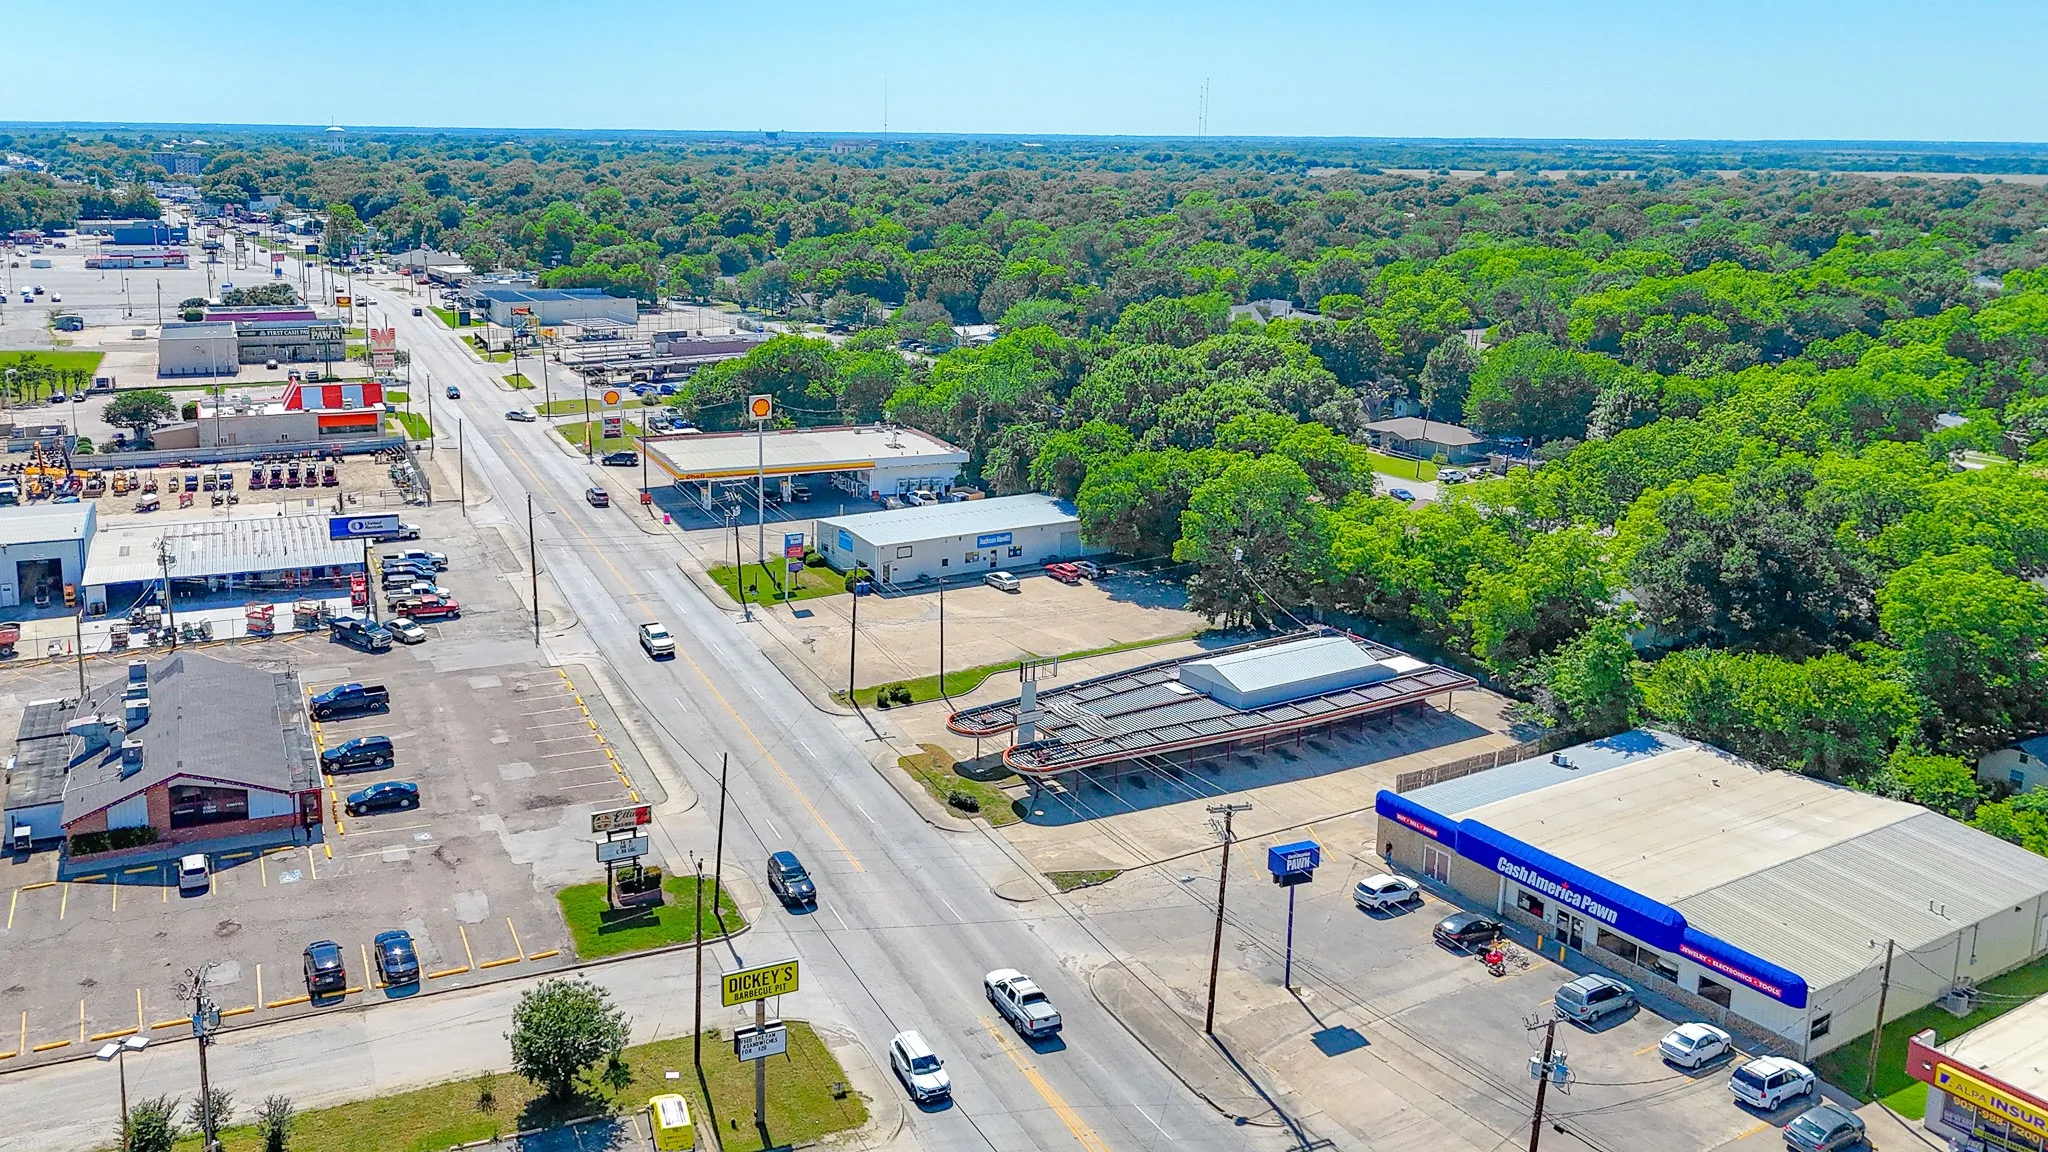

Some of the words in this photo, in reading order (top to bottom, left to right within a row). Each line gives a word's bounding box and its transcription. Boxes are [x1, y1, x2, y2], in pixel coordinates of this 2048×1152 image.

[310, 330, 340, 340] PAWN
[1287, 857, 1310, 871] PAWN
[729, 966, 793, 993] DICKEY'S
[1681, 946, 1707, 962] JEWELRY
[1712, 960, 1753, 983] ELECTRONICS
[1758, 980, 1781, 996] TOOLS
[734, 986, 772, 1001] BARBECUE
[775, 983, 787, 992] PIT
[1956, 1083, 1987, 1103] ALPA
[1990, 1096, 2048, 1133] INSUR
